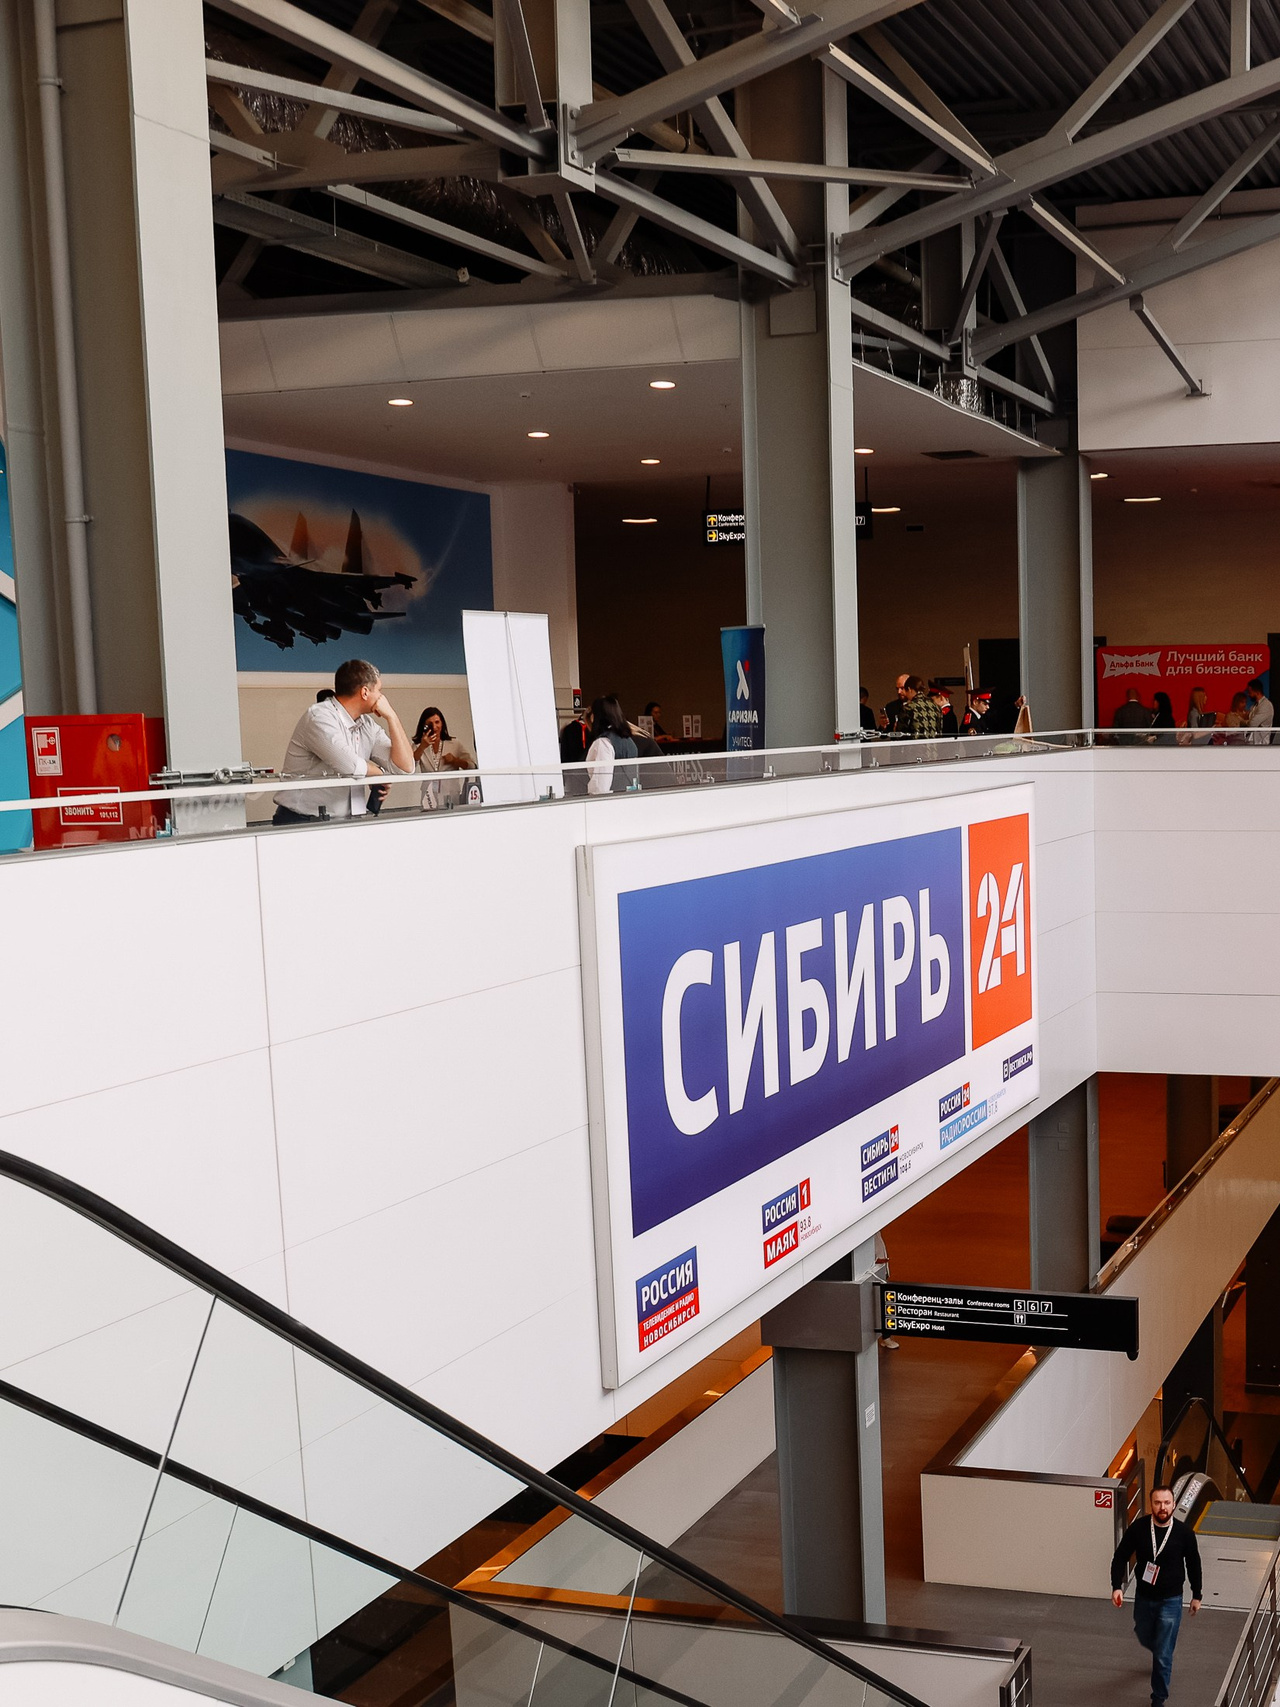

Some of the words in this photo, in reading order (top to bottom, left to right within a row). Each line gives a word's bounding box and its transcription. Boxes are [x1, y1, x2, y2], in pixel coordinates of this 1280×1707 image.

[719, 532, 745, 541] SkyExpo
[1166, 651, 1226, 664] Лучший
[1228, 651, 1263, 662] банк
[1109, 661, 1134, 670] Альфа
[1135, 660, 1155, 668] Банк
[1166, 665, 1193, 676] для
[1195, 663, 1256, 675] бизнеса
[470, 790, 478, 800] 15
[64, 806, 94, 816] ЗВОНИТЬ
[661, 888, 951, 1136] СИБИРЬ
[977, 862, 1026, 995] 24
[940, 1092, 961, 1117] РОССИЯ
[862, 1137, 889, 1165] СИБИРЬ
[890, 1130, 899, 1148] 24
[765, 1192, 797, 1226] РОССИЯ
[802, 1183, 807, 1205] 1
[766, 1227, 797, 1262] МАЯК
[641, 1259, 693, 1312] РОССИЯ
[897, 1292, 964, 1306] Конференц-залы
[966, 1299, 994, 1308] Conference
[1017, 1302, 1022, 1311] 5
[1030, 1302, 1036, 1311] 6
[1044, 1303, 1049, 1312] 7
[643, 1307, 676, 1331] ТЕЛЕВИДЕНИЕ
[679, 1292, 695, 1308] РАДИО
[897, 1305, 933, 1318] Ресторан
[643, 1305, 696, 1347] НОВОСИБИРСК
[898, 1319, 931, 1331] SkyExpo
